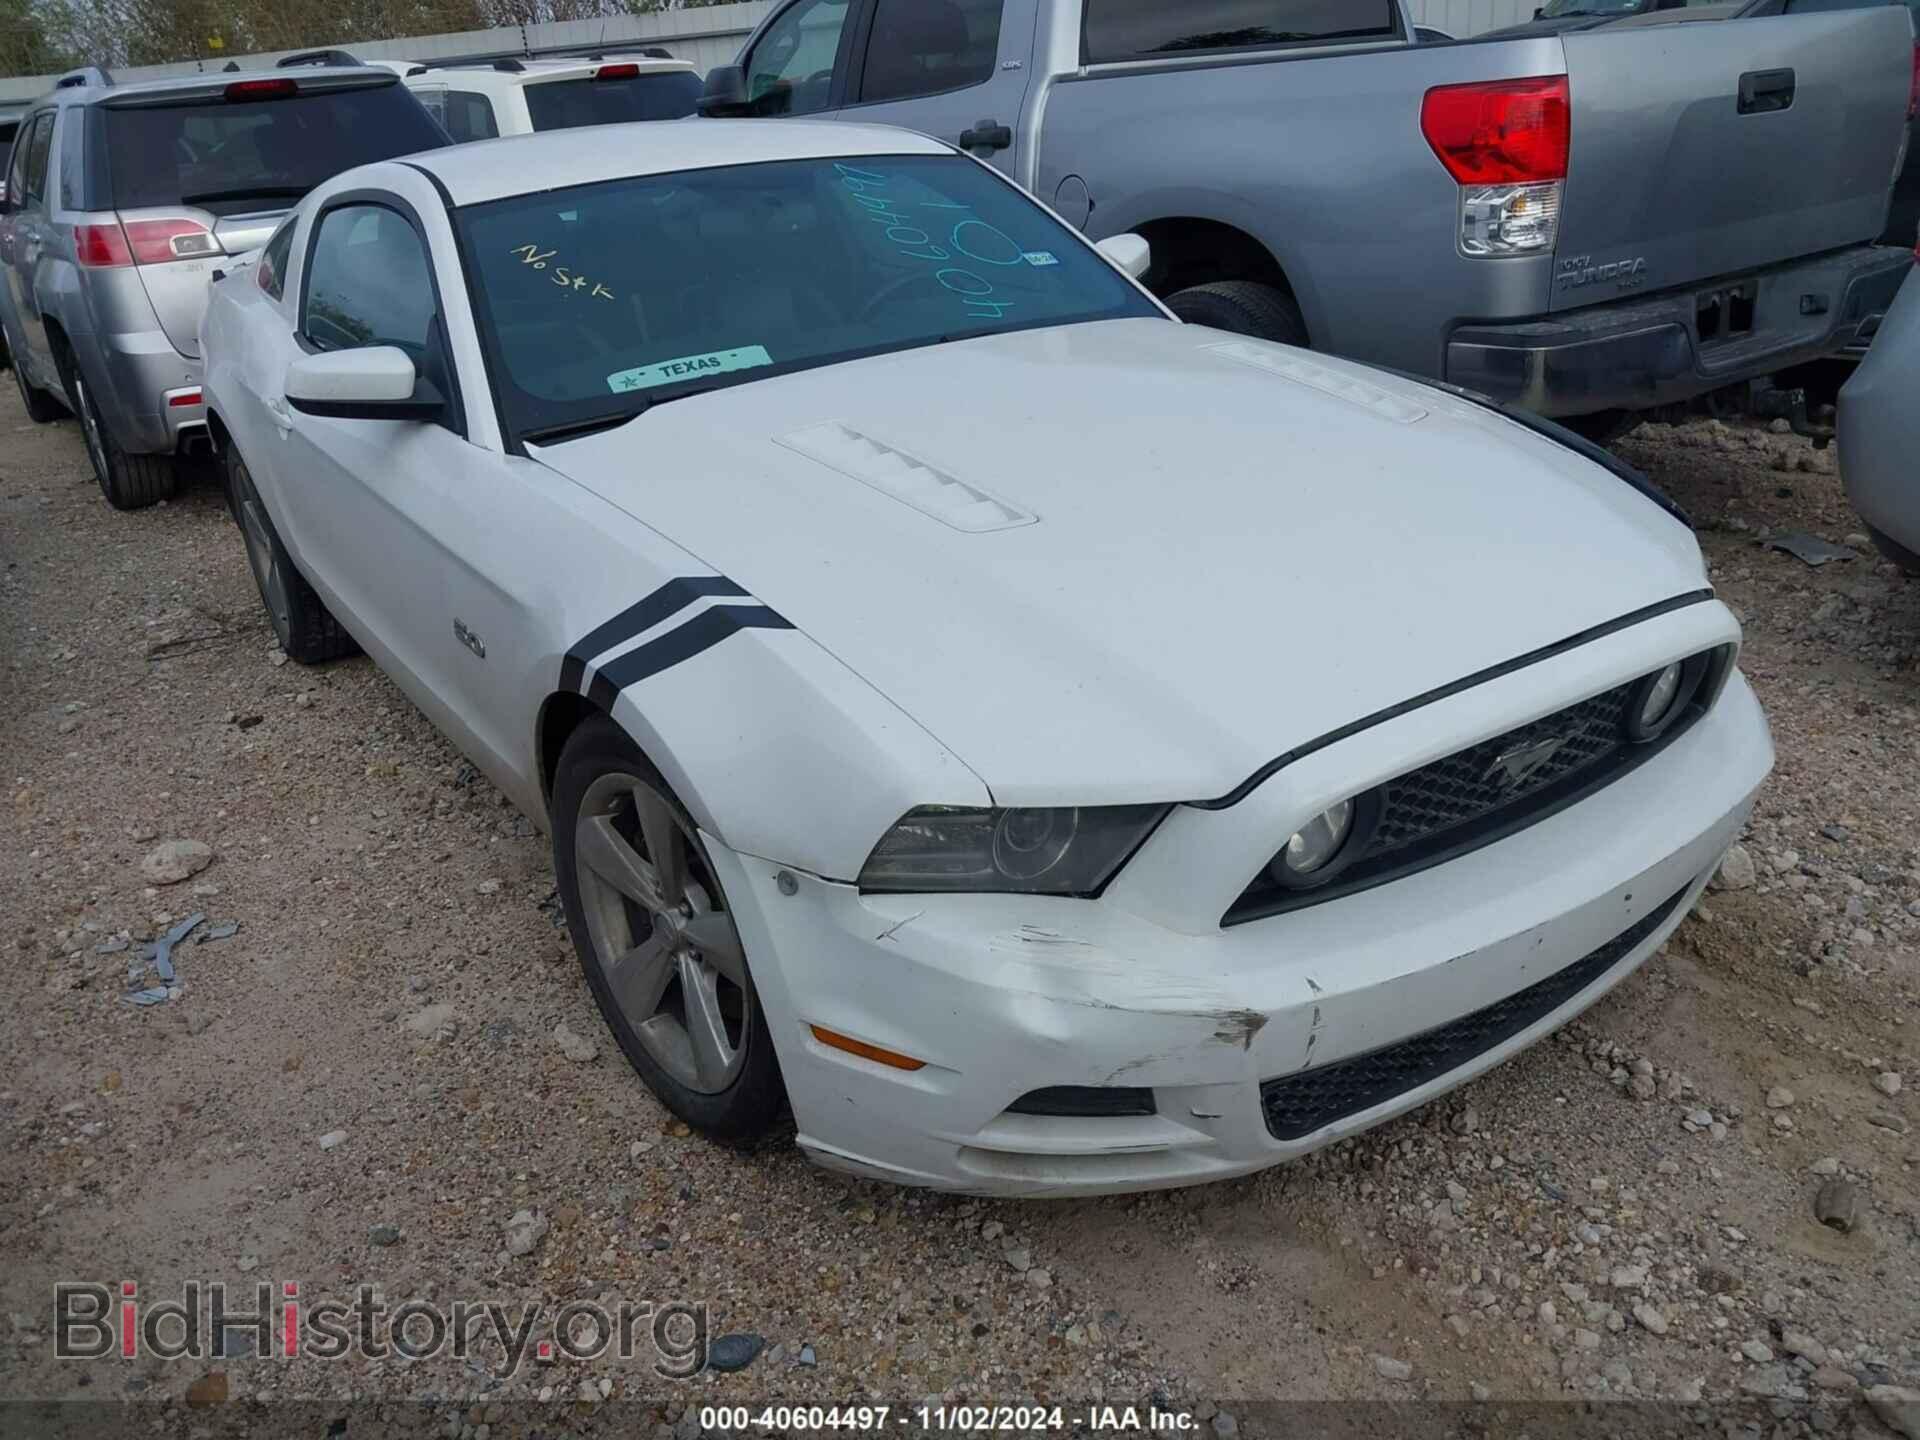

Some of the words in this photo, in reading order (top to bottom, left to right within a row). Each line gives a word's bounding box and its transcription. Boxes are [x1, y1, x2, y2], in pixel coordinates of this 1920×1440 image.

[834, 163, 1015, 318] 40604497
[509, 244, 557, 269] No
[659, 356, 721, 378] TEXAS
